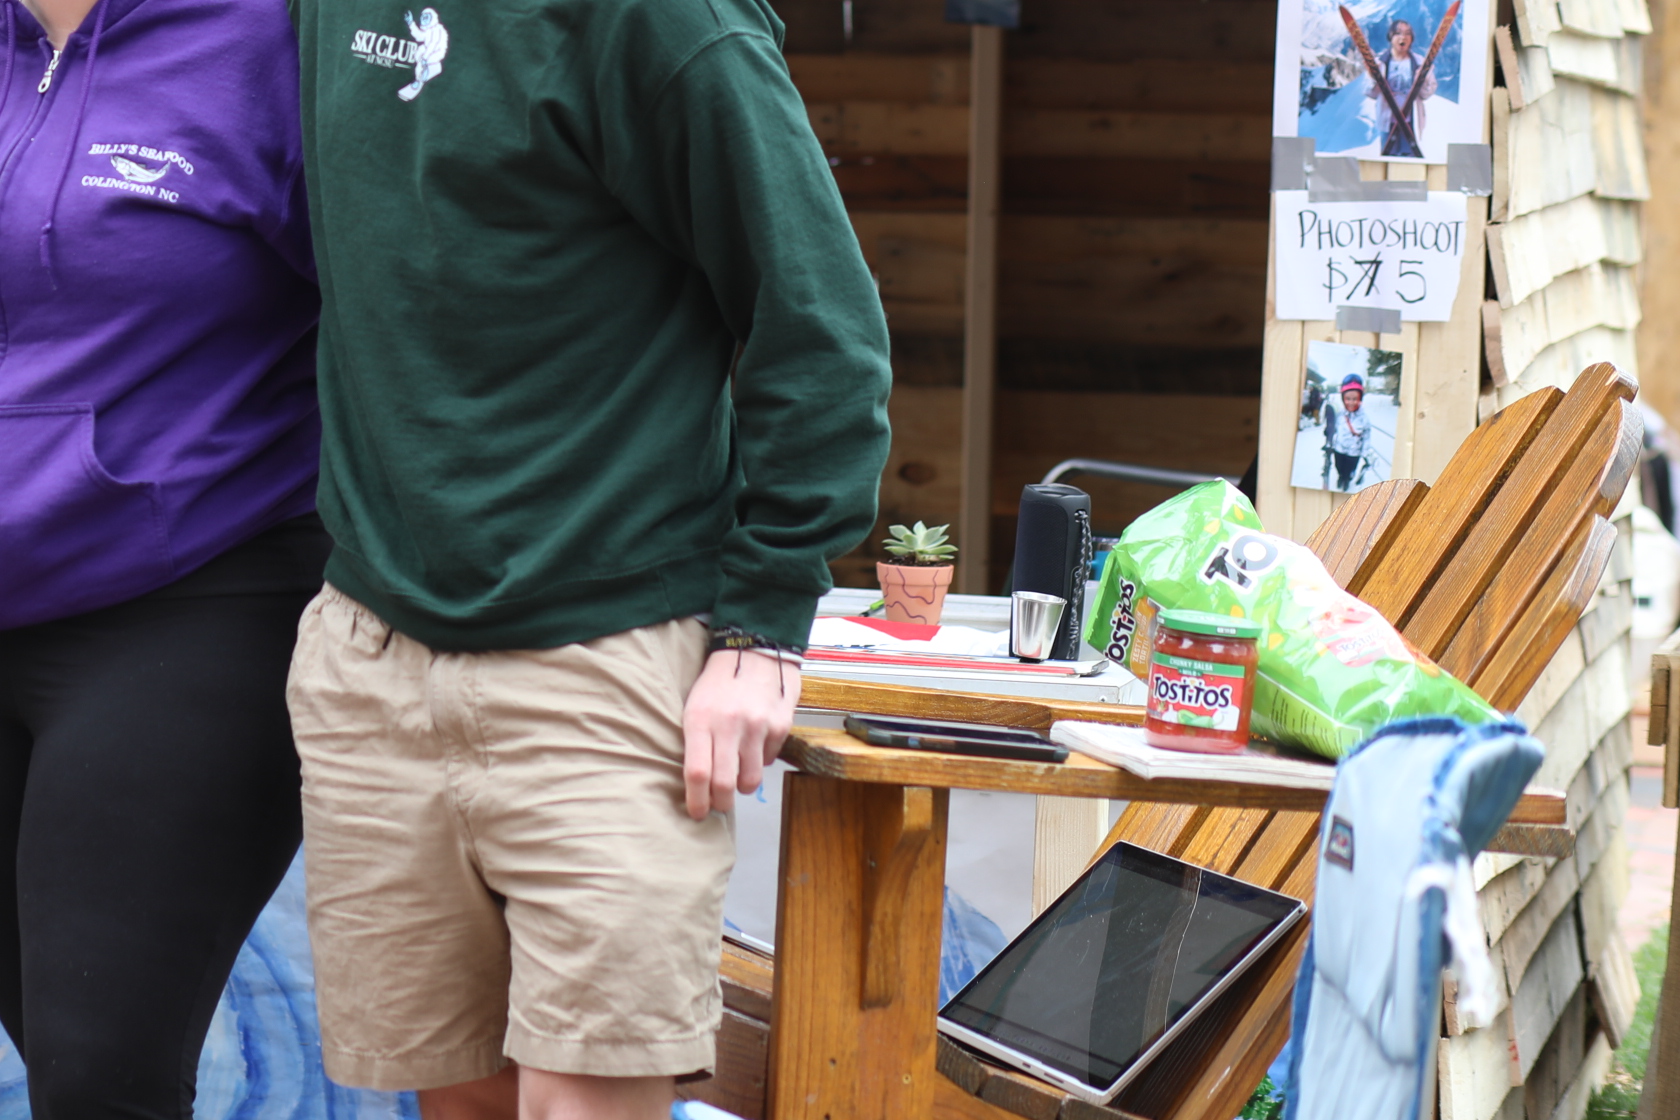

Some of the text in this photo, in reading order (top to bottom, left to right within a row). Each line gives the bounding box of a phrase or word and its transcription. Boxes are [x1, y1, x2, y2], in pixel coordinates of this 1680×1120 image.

[351, 29, 418, 64] SKI CLUB
[88, 143, 194, 175] BILLY'S SEAFOOD
[81, 175, 179, 203] COLINGTON NC
[1298, 209, 1464, 256] PHOTOSHOOT
[1193, 661, 1213, 672] SALSA
